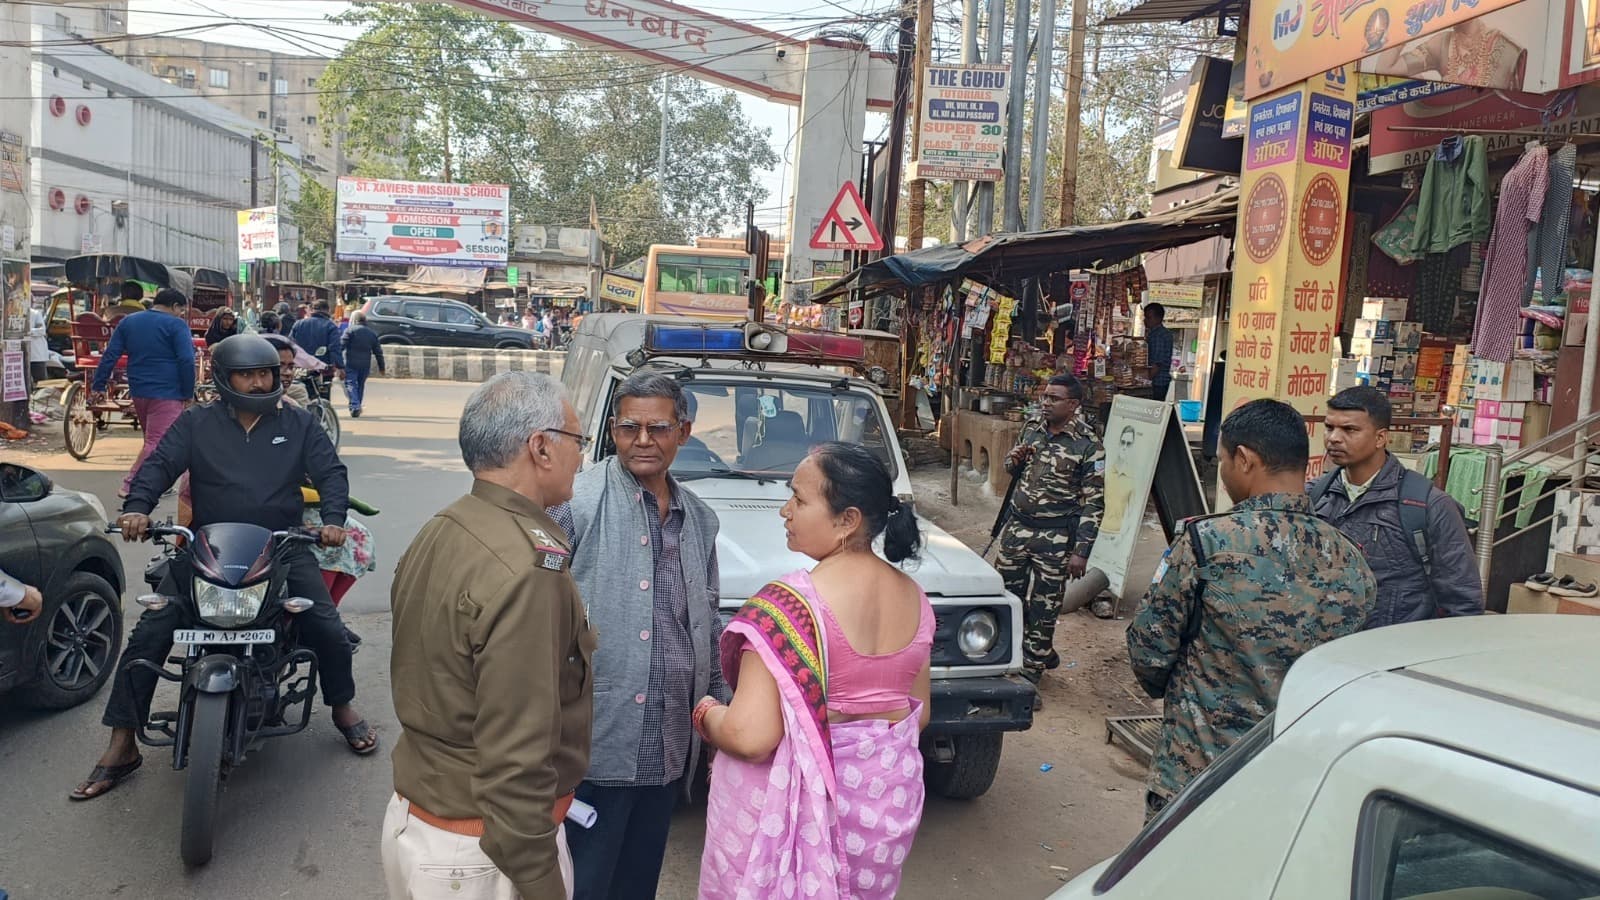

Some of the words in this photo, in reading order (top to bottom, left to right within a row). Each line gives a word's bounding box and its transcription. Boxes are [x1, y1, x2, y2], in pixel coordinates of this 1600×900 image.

[1273, 4, 1303, 40] MJ
[929, 69, 958, 87] THE
[961, 70, 1006, 89] GURU
[940, 89, 992, 100] TUTORIALS
[1398, 88, 1408, 100] के
[923, 122, 976, 135] SUPER
[981, 124, 1002, 136] 30
[1277, 120, 1291, 135] पूजा
[1334, 125, 1346, 139] पूजा
[924, 140, 953, 149] CLASS
[975, 143, 999, 152] CBSE
[1252, 139, 1290, 163] ऑफर
[1311, 137, 1344, 163] ऑफर
[356, 181, 369, 192] ST.
[374, 183, 414, 194] XAVIERS
[417, 184, 460, 196] MISSION
[462, 186, 502, 198] SCHOOL
[408, 206, 451, 214] ADVANCED
[396, 215, 450, 225] ADMISSION
[410, 227, 437, 237] OPEN
[466, 244, 507, 254] SESSION
[1249, 276, 1268, 302] प्रति
[1294, 280, 1319, 312] चाँदी
[1321, 281, 1335, 312] के
[1238, 312, 1249, 329] 10
[1252, 312, 1277, 331] ग्राम
[1235, 334, 1258, 359] सोने
[1260, 336, 1273, 360] के
[1290, 323, 1317, 354] जेवर
[1319, 323, 1332, 354] में
[1233, 362, 1256, 388] जेवर
[1259, 365, 1271, 390] में
[1288, 365, 1327, 397] मेकिंग
[176, 631, 196, 642] JH
[203, 631, 215, 641] 10
[220, 632, 239, 642] AJ
[244, 631, 272, 641] 2076
